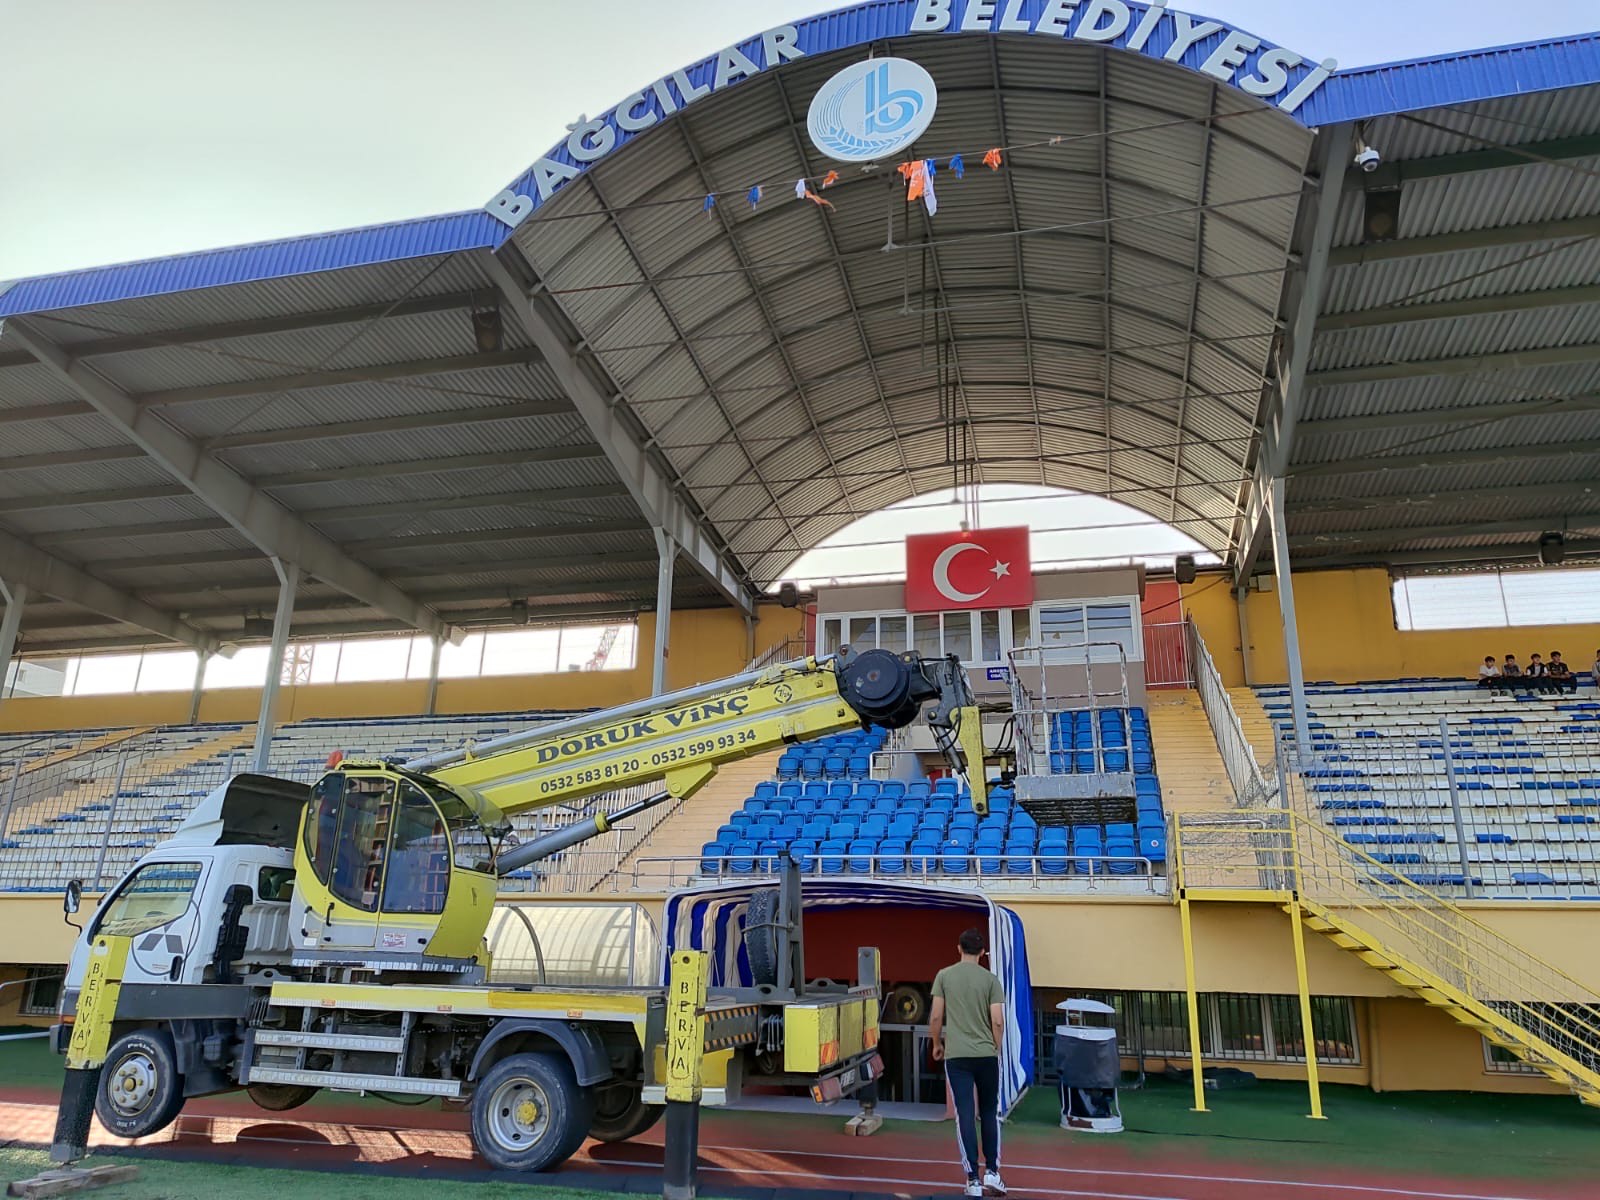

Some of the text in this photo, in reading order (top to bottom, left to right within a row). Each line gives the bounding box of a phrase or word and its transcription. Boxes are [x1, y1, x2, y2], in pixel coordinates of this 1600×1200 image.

[485, 0, 1338, 228] BAĞCILAR BELEDİYESİ
[536, 718, 658, 764] DORUK
[540, 775, 573, 793] 0532
[577, 768, 601, 785] 583
[605, 763, 619, 778] 81
[622, 758, 640, 773] 20
[651, 746, 686, 766] 0532
[689, 739, 715, 757] 599
[718, 734, 735, 750] 93
[738, 728, 757, 745] 34
[76, 962, 101, 1041] BERVA
[675, 981, 691, 1070] BERVA
